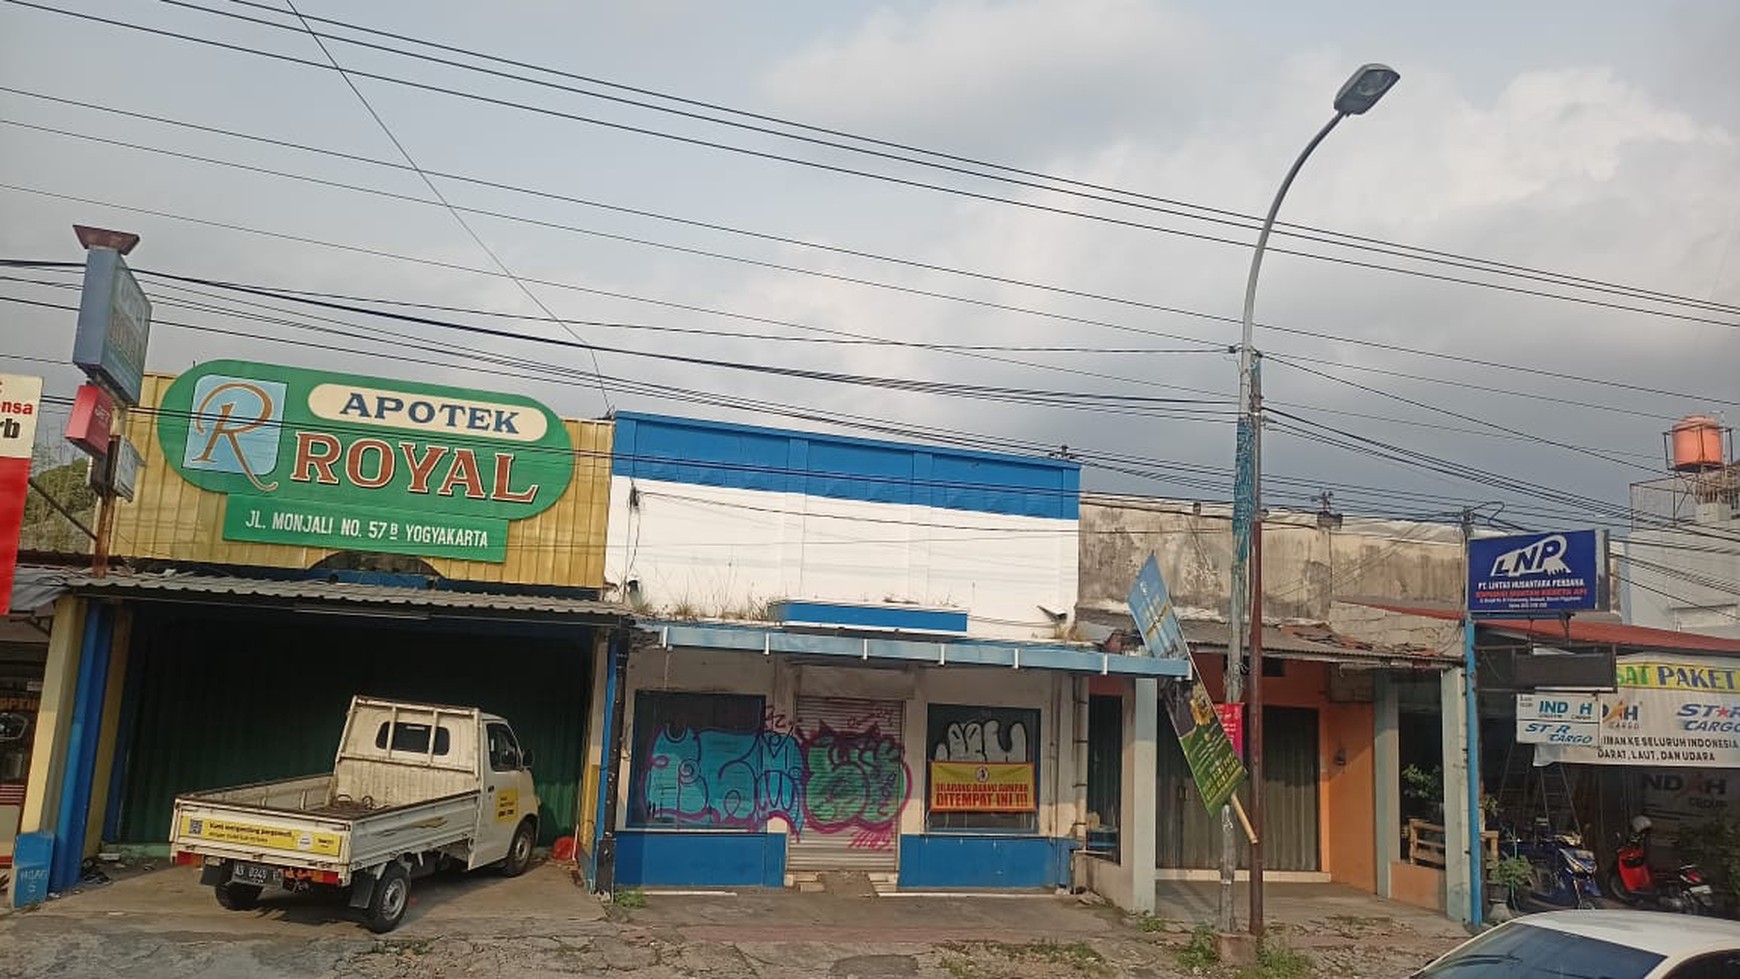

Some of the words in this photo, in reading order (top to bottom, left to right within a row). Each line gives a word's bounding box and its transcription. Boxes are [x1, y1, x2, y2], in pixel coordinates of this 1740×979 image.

[0, 401, 33, 415] nsa
[339, 392, 520, 434] APOTEK
[0, 418, 20, 438] b
[289, 431, 539, 503] ROYAL
[245, 510, 266, 529] JL.
[271, 512, 334, 535] MONJALI
[340, 518, 362, 538] NO.
[405, 527, 488, 548] YOGYAKARTA
[1657, 666, 1735, 689] PAKET
[1549, 734, 1593, 743] CARGO
[1641, 737, 1685, 747] SELURUH
[1688, 738, 1739, 748] INDONESIA
[1661, 751, 1680, 760] DAN
[1682, 751, 1715, 760] UDARA
[936, 793, 992, 807] DITEMPAT
[996, 793, 1012, 807] INI
